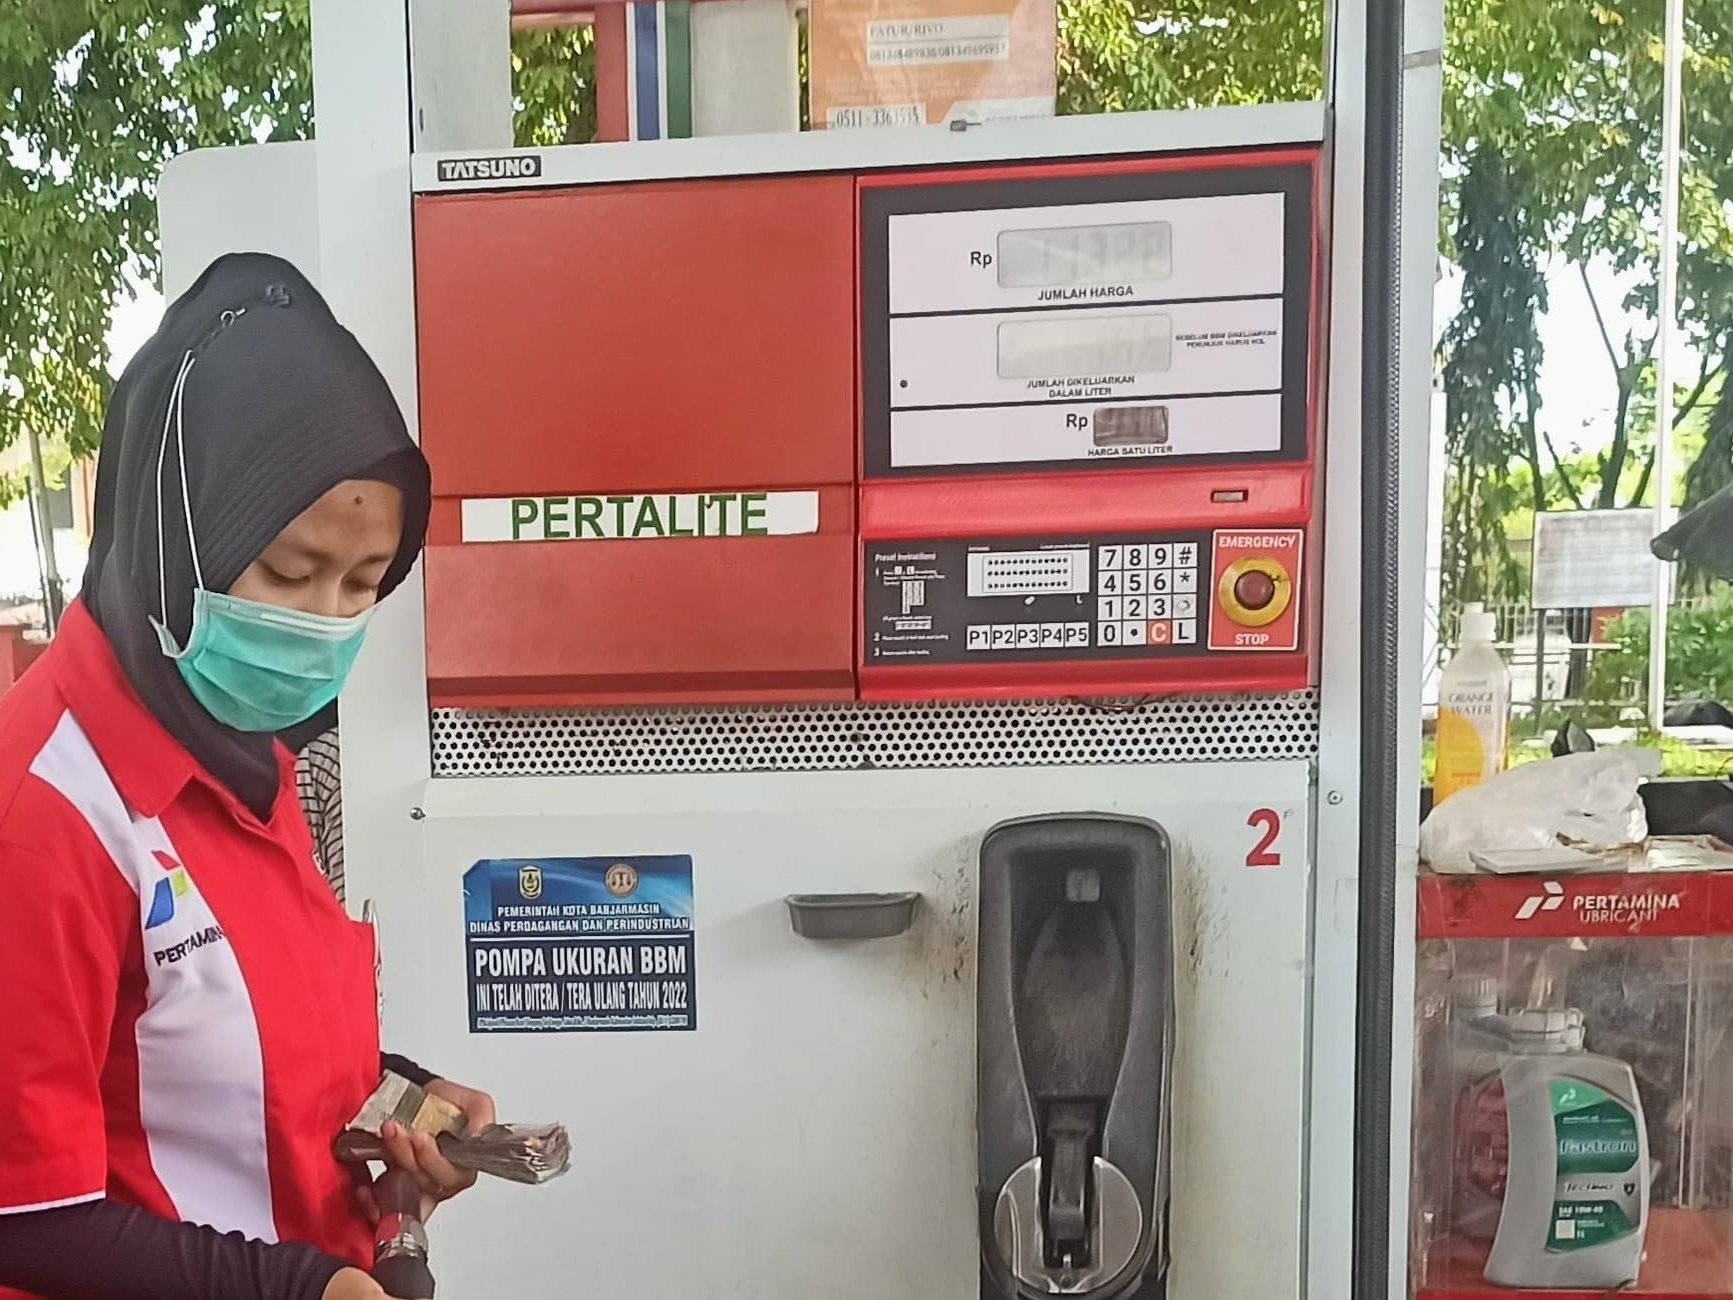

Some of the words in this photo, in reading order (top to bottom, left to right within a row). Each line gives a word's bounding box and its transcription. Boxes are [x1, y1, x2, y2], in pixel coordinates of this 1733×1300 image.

[441, 158, 536, 179] TATSUNO
[970, 251, 992, 268] Rp
[1038, 287, 1087, 301] JUMLAH
[1091, 285, 1134, 298] HARGA
[1027, 378, 1065, 390] JUMLAH
[1067, 375, 1135, 387] DIKELUARKAN
[1049, 388, 1082, 398] DALAM
[1084, 387, 1112, 396] LITER
[1066, 413, 1088, 430] Rp
[1088, 447, 1119, 456] HARGA
[1122, 446, 1145, 455] SATU
[1147, 445, 1173, 454] LITER
[512, 493, 768, 539] PERTALITE
[1218, 536, 1297, 548] EMERGENCY
[1103, 549, 1117, 567] 7
[1129, 548, 1141, 566] 8
[1154, 547, 1166, 565] 9
[1103, 574, 1116, 592] 4
[1129, 573, 1141, 592] 5
[1154, 572, 1166, 591] 6
[1105, 600, 1113, 618] 1
[1129, 599, 1141, 617] 2
[1153, 598, 1166, 616] 3
[969, 630, 989, 645] P1
[993, 630, 1014, 644] P2
[1017, 629, 1038, 643] P3
[1041, 629, 1063, 643] P4
[1066, 628, 1088, 642] P5
[1103, 624, 1116, 642] 0
[1151, 622, 1167, 641] C
[1178, 622, 1189, 640] L
[1235, 633, 1270, 645] STOP
[1448, 692, 1493, 703] ORANGE
[1451, 705, 1491, 715] WATER
[1246, 808, 1280, 866] 2
[497, 906, 560, 917] PEMERINTAH
[563, 905, 587, 916] KOTA
[590, 903, 660, 915] BANJARMASIN
[1573, 894, 1680, 910] PERTAMINA
[469, 921, 501, 933] DINAS
[504, 919, 579, 932] PERDAGANGAN
[582, 919, 603, 931] DAN
[606, 917, 690, 931] PERINDUSTRIAN
[475, 947, 546, 977] POMPA
[553, 946, 633, 976] UKURAN
[640, 945, 686, 975] BBM
[476, 983, 490, 1011] INI
[492, 983, 523, 1011] TELAH
[524, 982, 559, 1011] DITERA
[566, 982, 591, 1010] TERA
[594, 982, 625, 1010] ULANG
[628, 981, 660, 1010] TAHUN
[662, 981, 687, 1009] 2022
